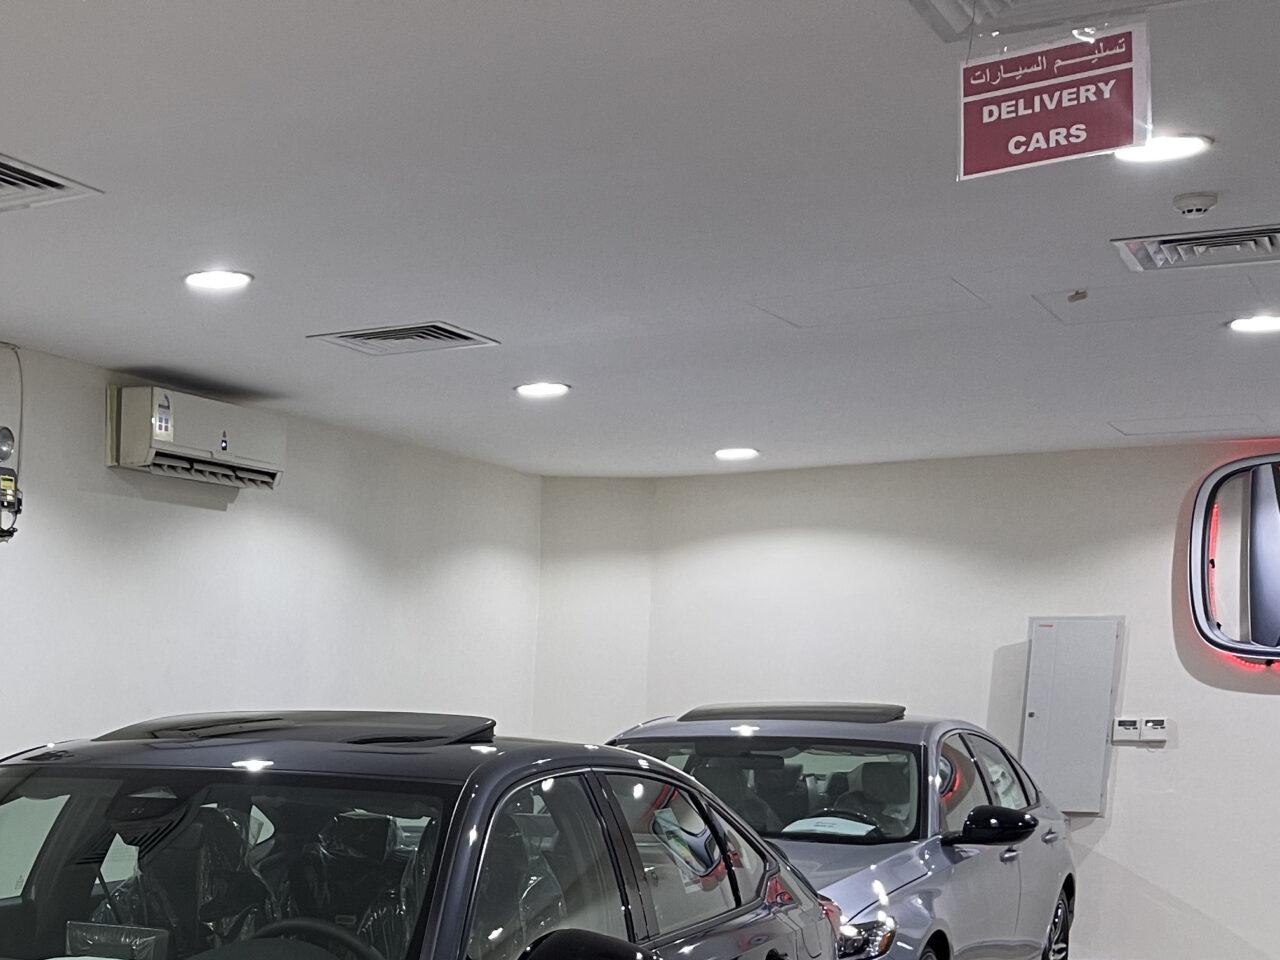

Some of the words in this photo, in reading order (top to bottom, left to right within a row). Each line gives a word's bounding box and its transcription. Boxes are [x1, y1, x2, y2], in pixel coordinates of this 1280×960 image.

[970, 55, 1047, 85] السيارات
[982, 79, 1116, 123] DELIVERY
[1007, 123, 1087, 155] CARS
